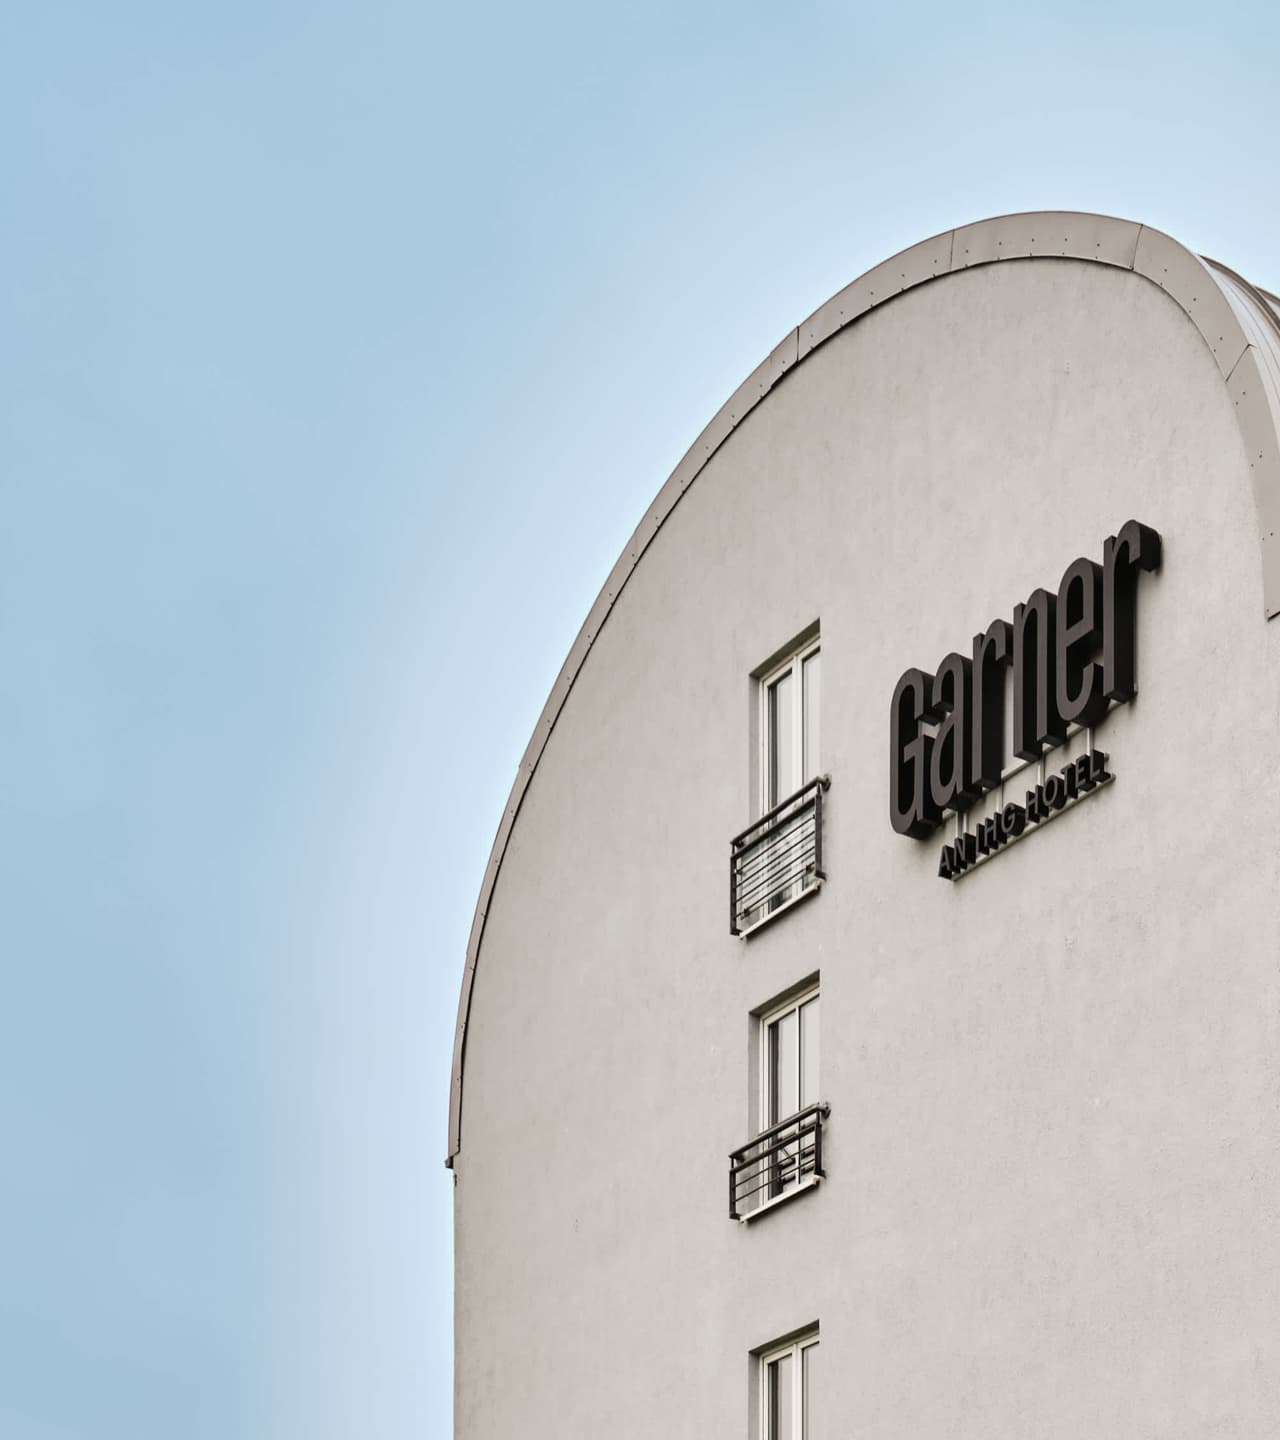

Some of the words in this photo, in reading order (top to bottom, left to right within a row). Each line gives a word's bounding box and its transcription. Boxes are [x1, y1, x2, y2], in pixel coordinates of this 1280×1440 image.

[890, 519, 1162, 841] Garner
[938, 832, 977, 879] AN
[976, 802, 1026, 855] IHG
[1025, 749, 1110, 824] HOTEL
